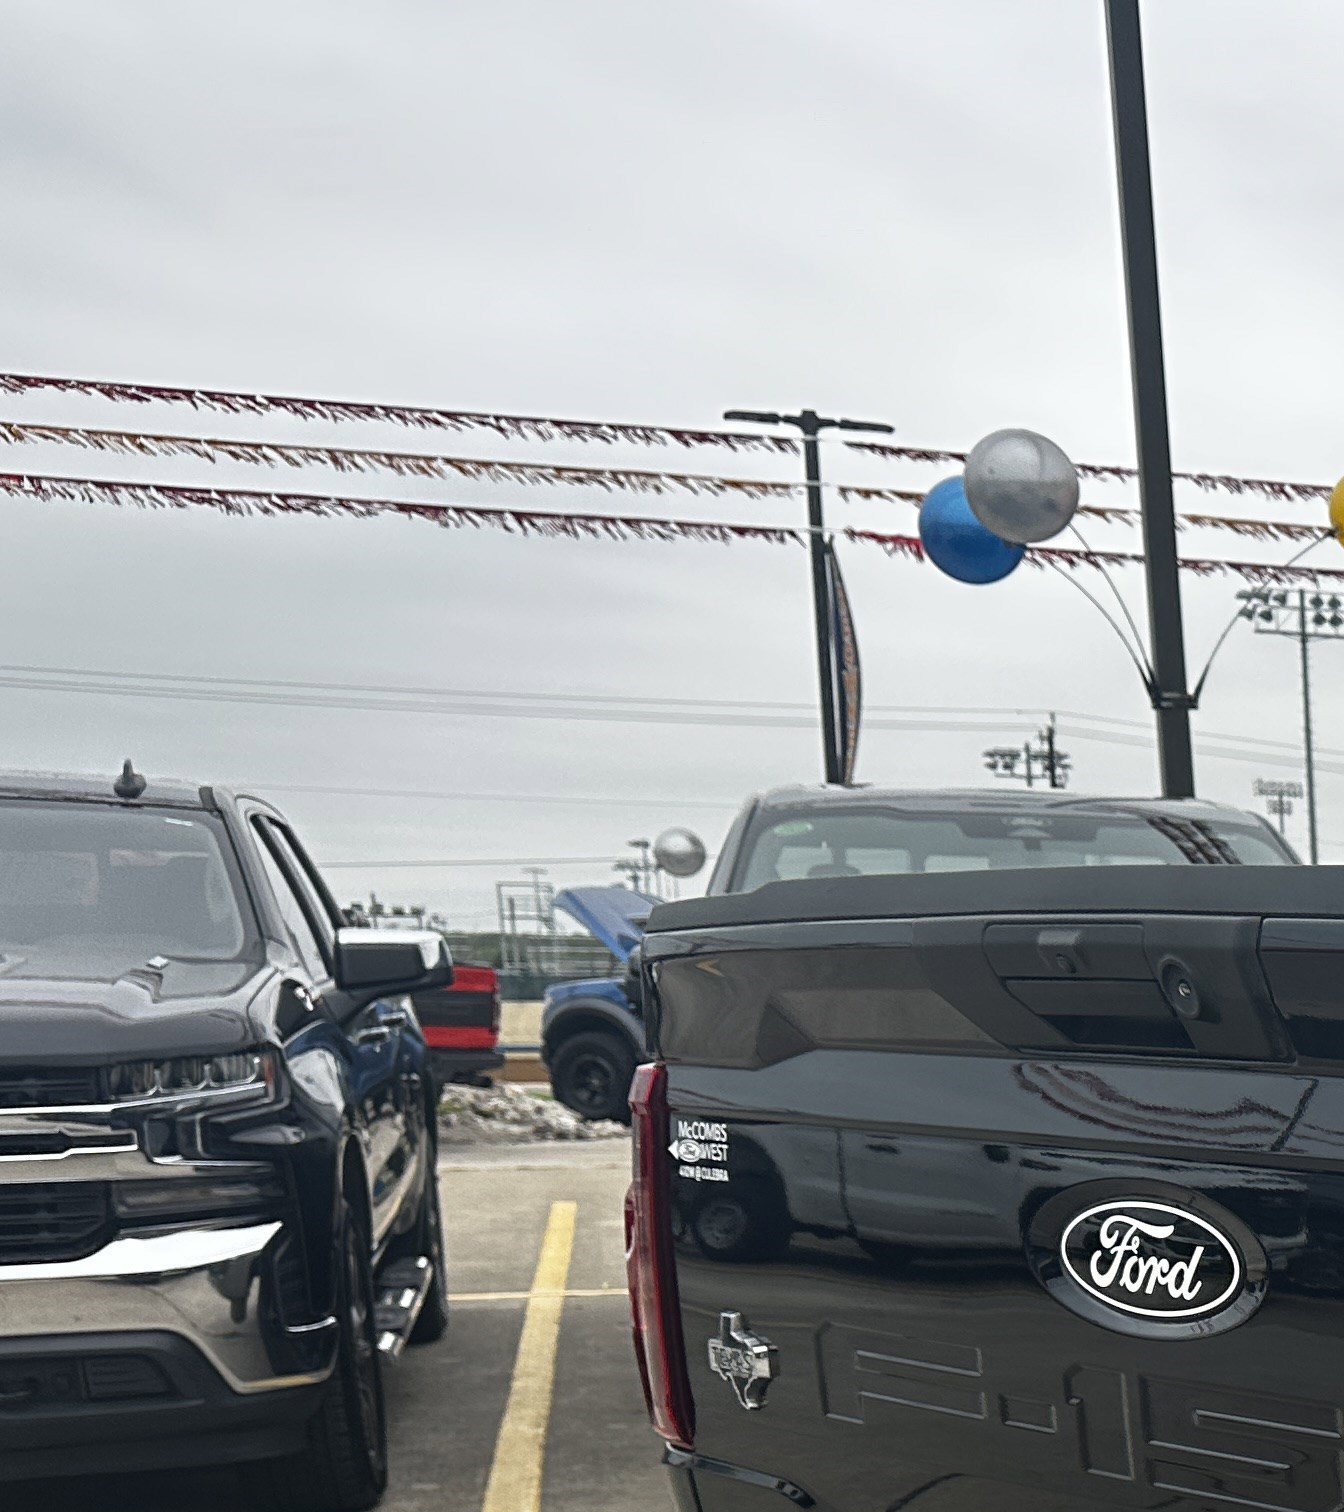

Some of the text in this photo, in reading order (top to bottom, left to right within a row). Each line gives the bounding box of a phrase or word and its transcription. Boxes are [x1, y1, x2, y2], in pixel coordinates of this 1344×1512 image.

[678, 1120, 728, 1142] McCOMBS
[700, 1143, 729, 1161] WEST
[1090, 1214, 1205, 1300] Ford
